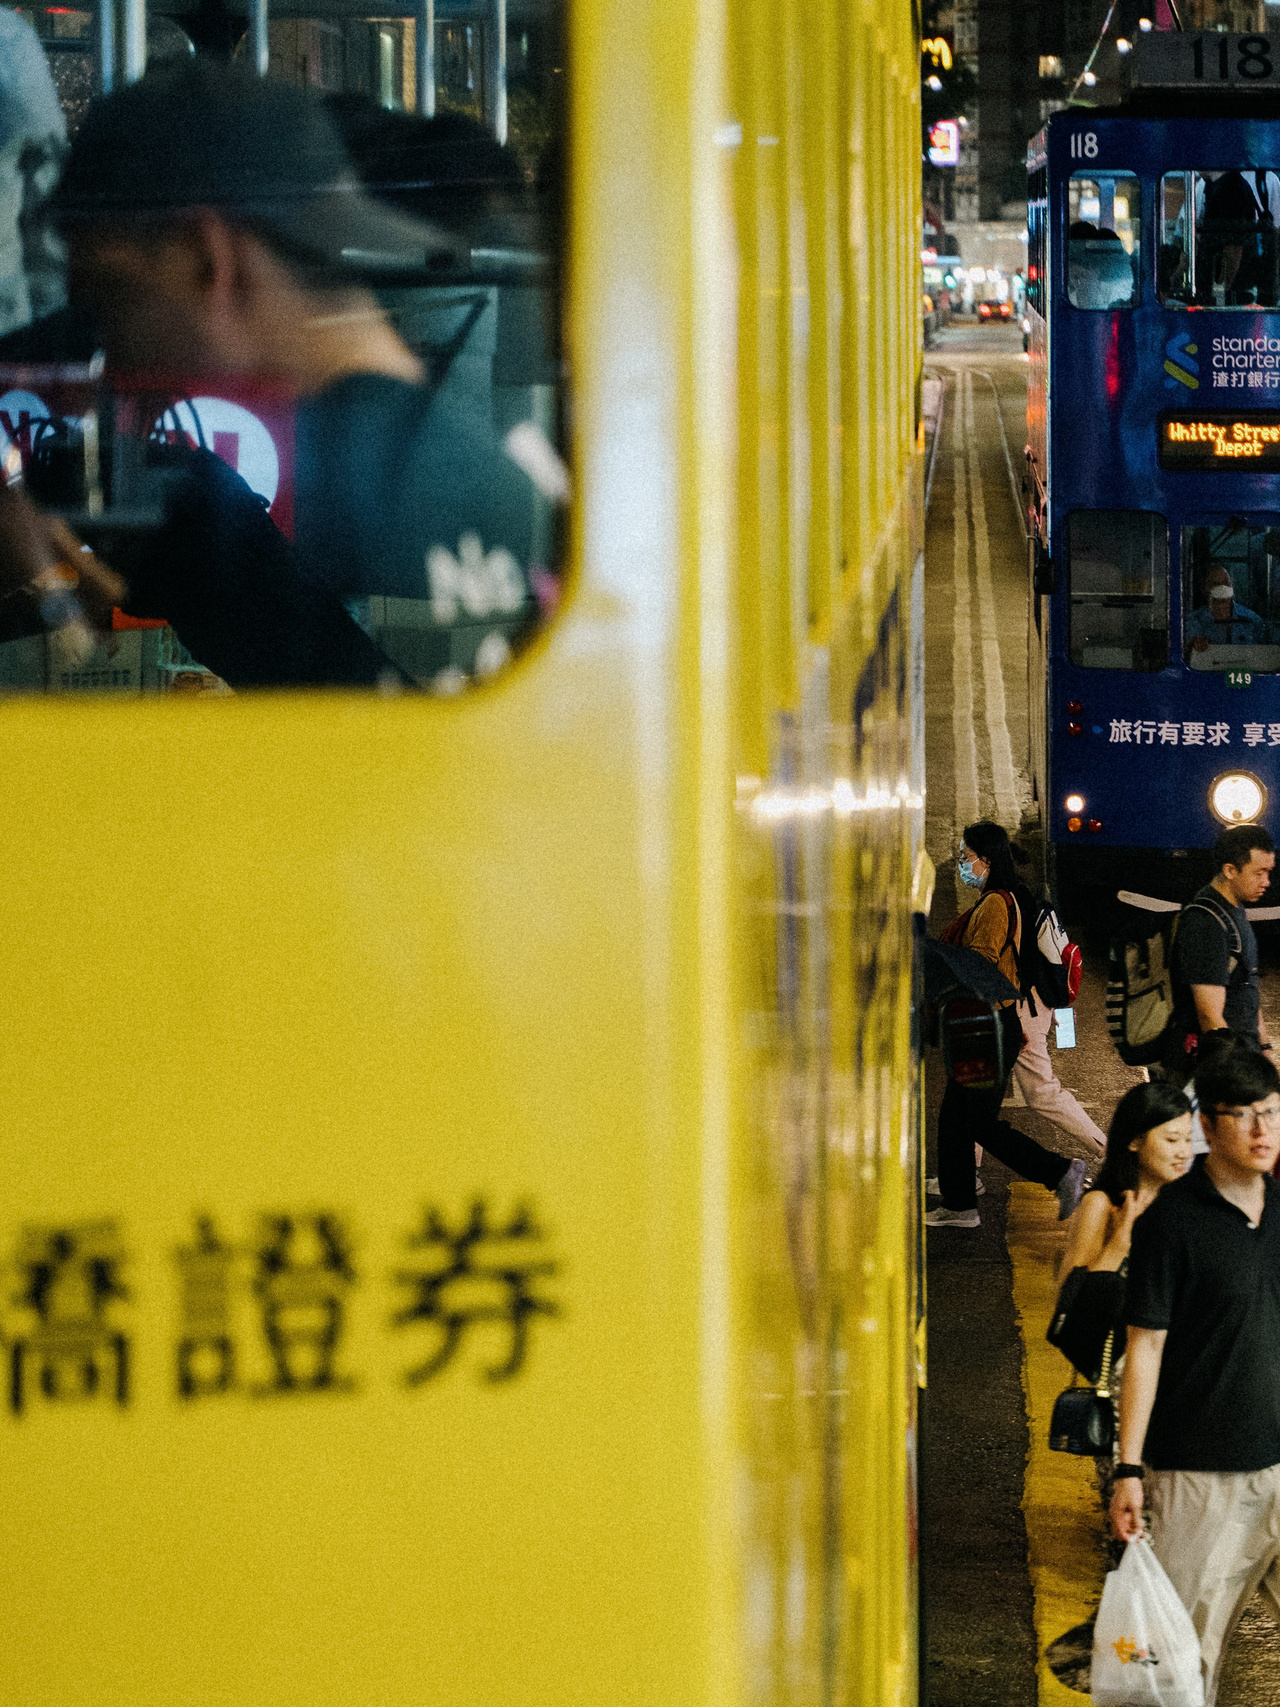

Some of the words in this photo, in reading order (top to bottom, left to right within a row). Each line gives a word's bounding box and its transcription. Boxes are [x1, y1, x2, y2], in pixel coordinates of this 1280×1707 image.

[1191, 36, 1274, 80] 118
[1070, 132, 1099, 159] 118
[1211, 371, 1280, 389] 渣打銀行
[1167, 422, 1227, 442] Whitty
[1214, 438, 1264, 458] Depot
[1227, 672, 1252, 685] 149
[1108, 719, 1231, 747] 旅行有要求
